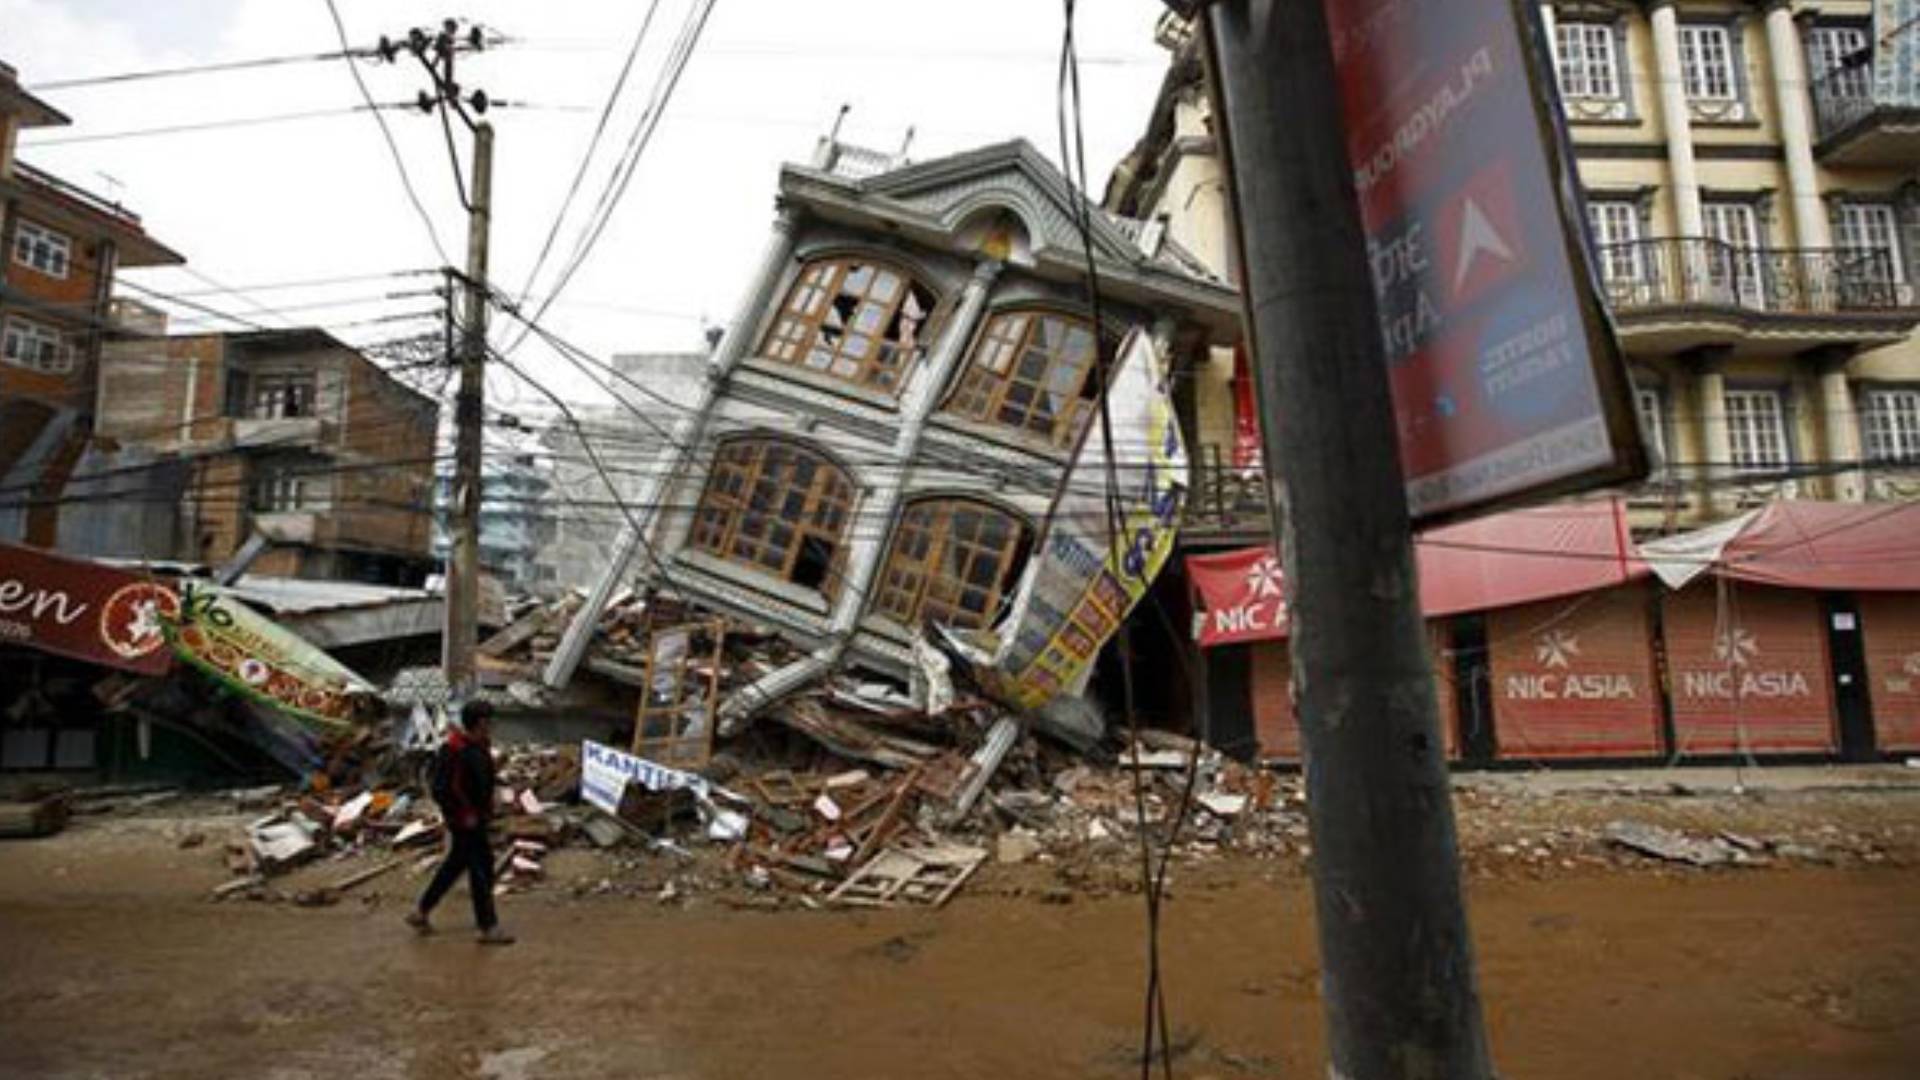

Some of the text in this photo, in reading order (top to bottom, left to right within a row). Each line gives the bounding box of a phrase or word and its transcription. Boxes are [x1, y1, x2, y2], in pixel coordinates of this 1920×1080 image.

[1216, 605, 1267, 632] NIC
[1508, 674, 1635, 699] NIC ASIA
[1685, 671, 1809, 698] NIC ASIA
